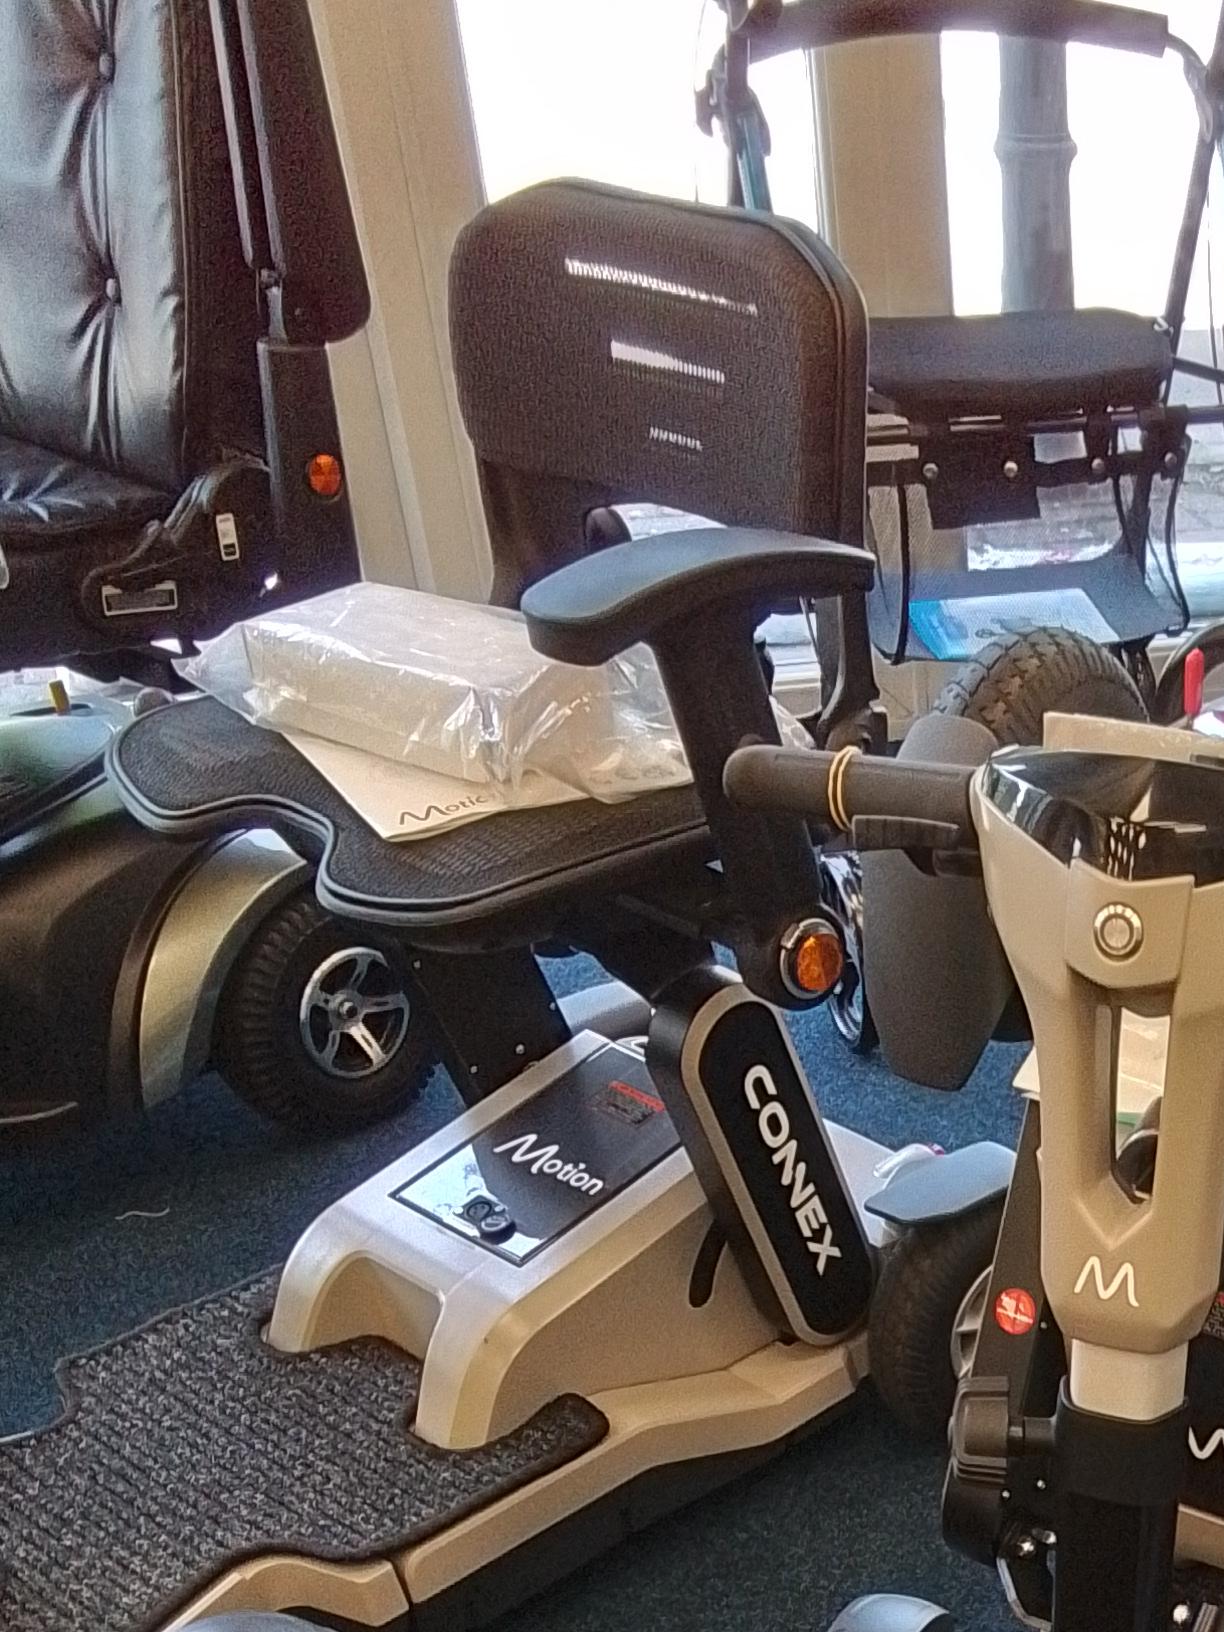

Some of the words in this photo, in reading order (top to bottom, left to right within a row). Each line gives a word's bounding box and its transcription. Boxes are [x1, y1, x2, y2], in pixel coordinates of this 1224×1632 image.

[399, 795, 489, 826] Moti
[493, 1133, 604, 1196] Motion
[743, 1064, 843, 1277] CONNEX
